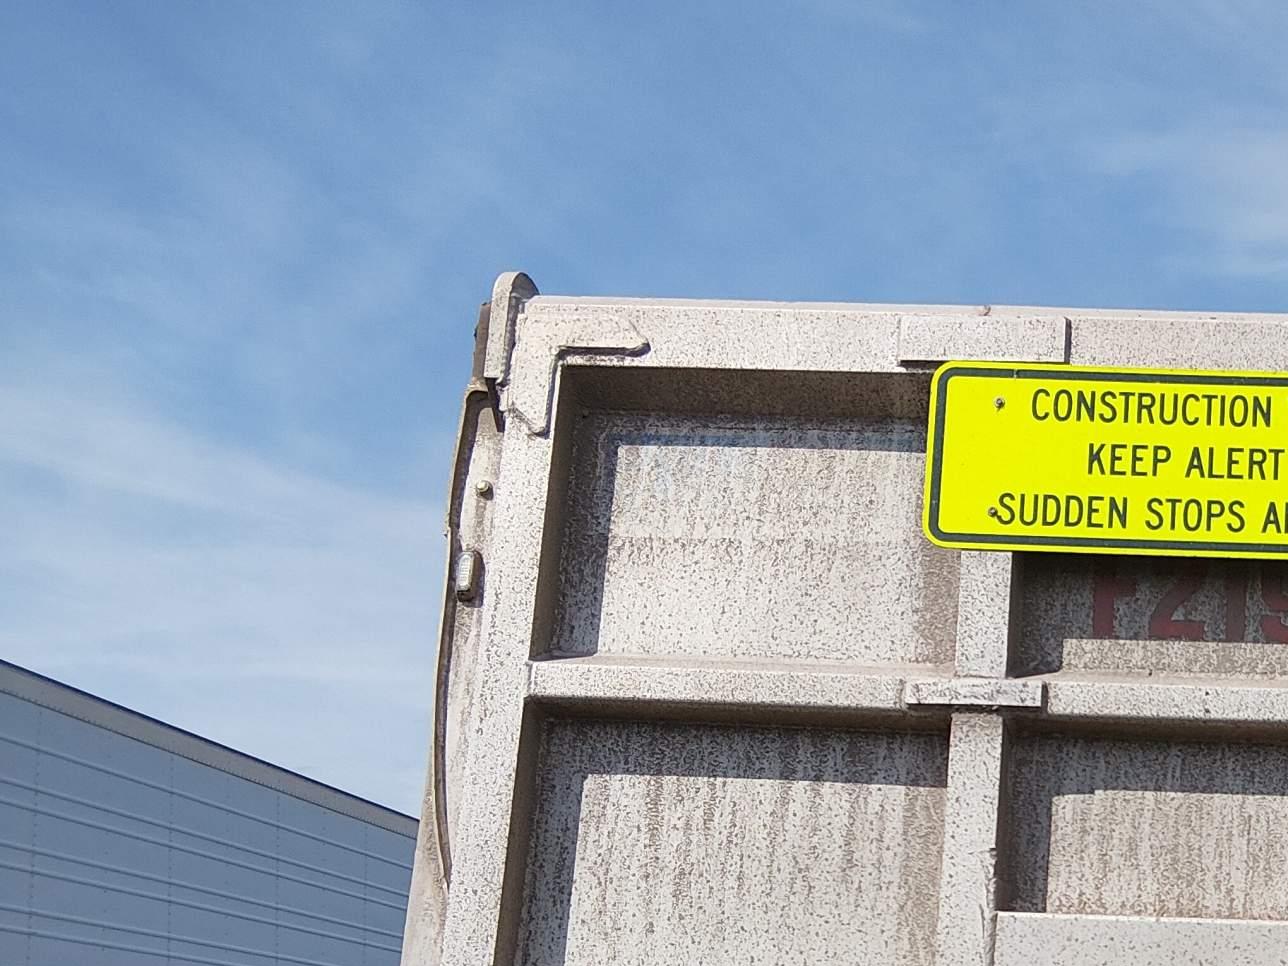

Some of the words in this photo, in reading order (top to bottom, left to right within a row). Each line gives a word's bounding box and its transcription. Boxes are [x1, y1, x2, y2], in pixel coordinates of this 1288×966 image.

[1032, 388, 1271, 428] CONSTRUCTION
[1087, 443, 1172, 477] KEEP
[1184, 446, 1283, 481] ALERT
[998, 493, 1128, 529] SUDDEN
[1145, 497, 1246, 533] STOPS
